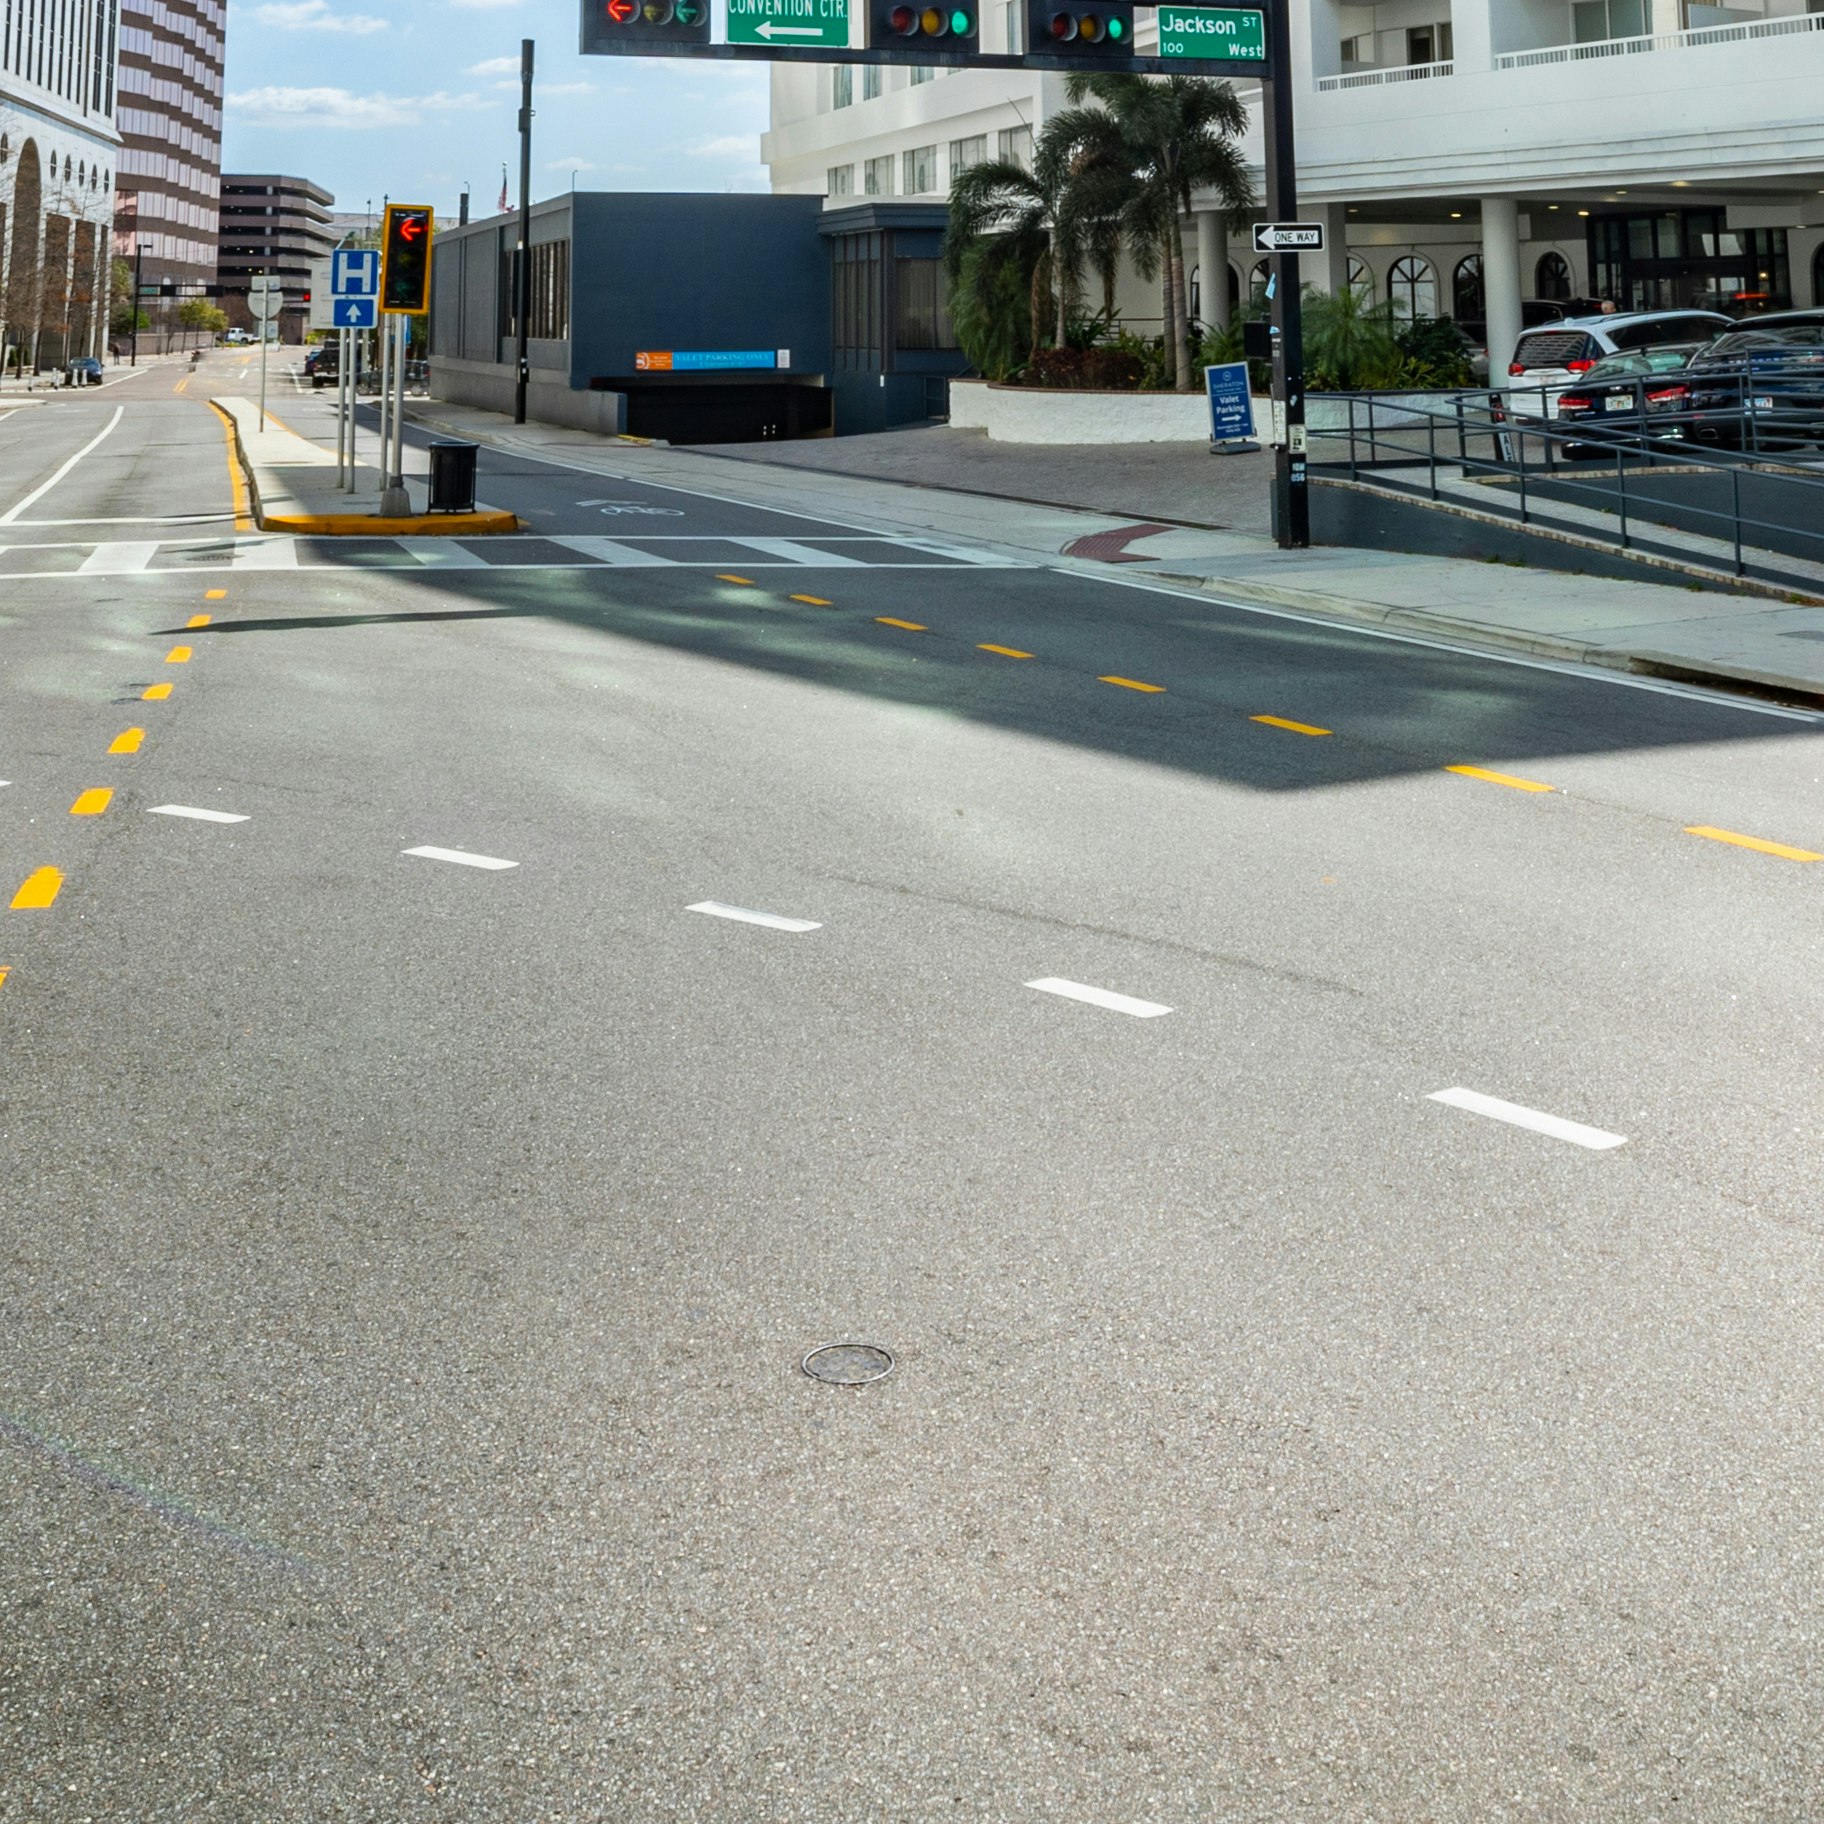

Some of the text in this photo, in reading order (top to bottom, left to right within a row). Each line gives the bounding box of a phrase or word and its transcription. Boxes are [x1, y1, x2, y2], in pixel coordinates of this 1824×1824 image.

[1161, 14, 1257, 35] Jackson ST
[1163, 42, 1262, 56] 100 West
[1275, 232, 1315, 242] ONE WAY
[337, 253, 372, 293] H
[1219, 396, 1239, 404] Valet
[1216, 405, 1246, 414] Parking
